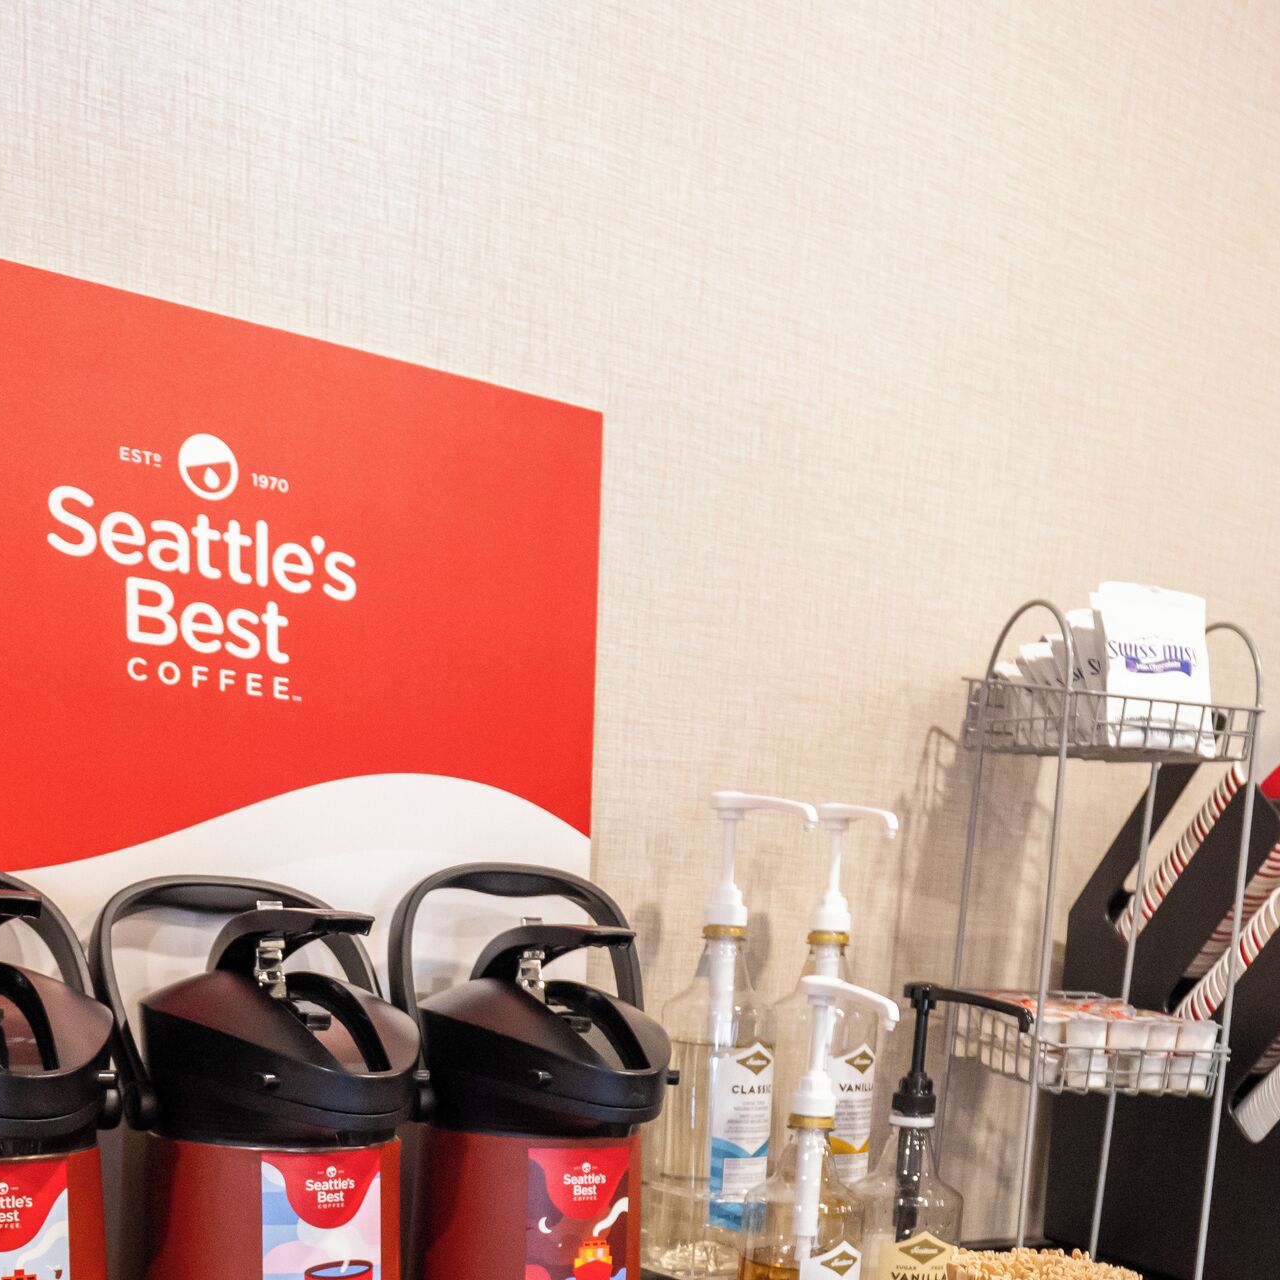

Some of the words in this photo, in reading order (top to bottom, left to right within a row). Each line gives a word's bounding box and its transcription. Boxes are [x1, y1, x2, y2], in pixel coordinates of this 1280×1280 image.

[252, 472, 289, 492] 1970
[47, 485, 357, 601] Seattle's
[126, 576, 289, 664] Best
[305, 1178, 355, 1191] Seattle's
[563, 1173, 606, 1184] Seattle's
[574, 1185, 596, 1195] Best
[317, 1191, 344, 1203] Best
